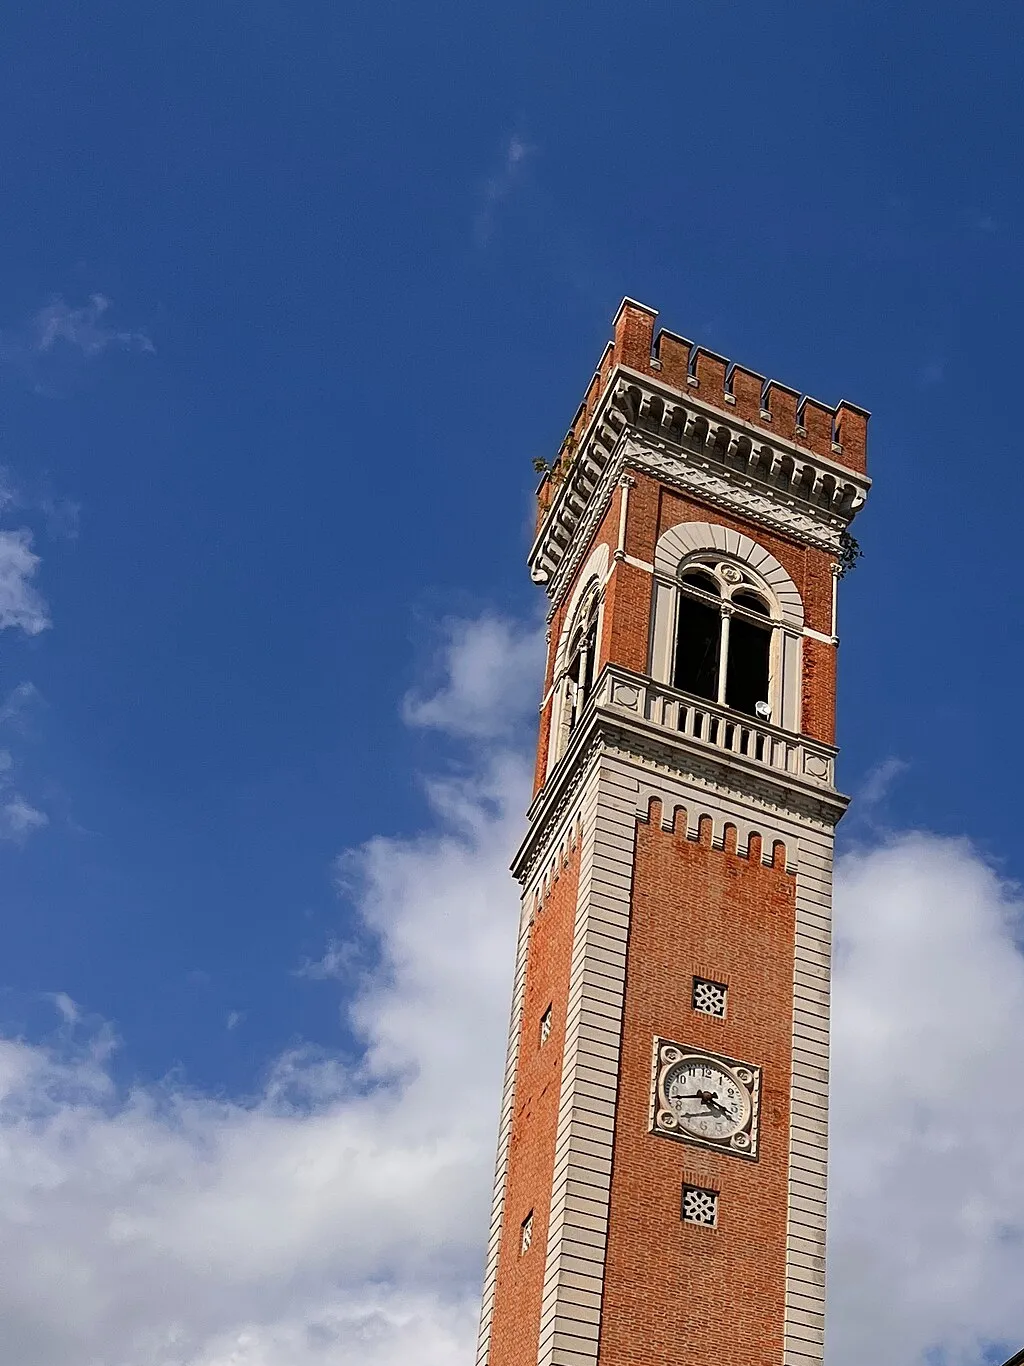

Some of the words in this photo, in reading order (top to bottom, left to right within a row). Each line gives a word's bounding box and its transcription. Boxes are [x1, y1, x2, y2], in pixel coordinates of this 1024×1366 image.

[688, 1068, 696, 1077] 11
[701, 1068, 712, 1079] 12
[677, 1075, 687, 1085] 10
[718, 1076, 723, 1086] 1
[728, 1088, 735, 1099] 2
[675, 1100, 683, 1111] 8
[700, 1120, 708, 1131] 6
